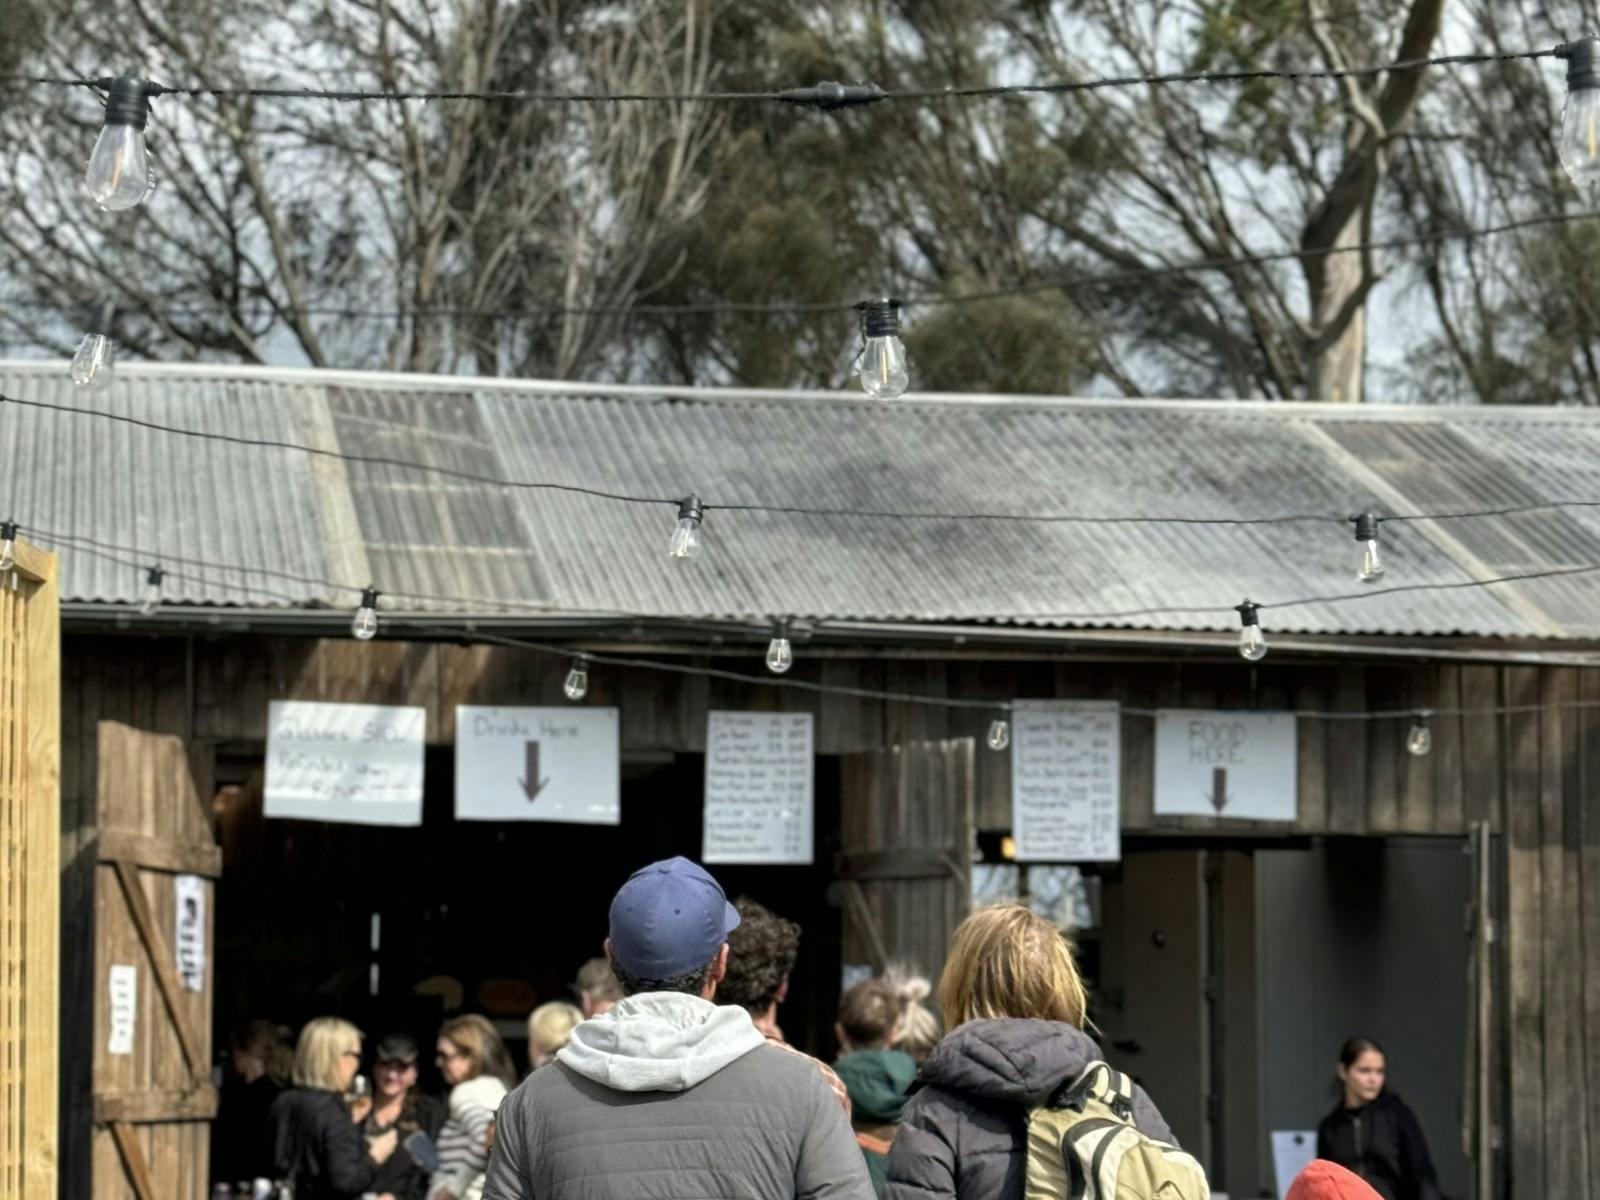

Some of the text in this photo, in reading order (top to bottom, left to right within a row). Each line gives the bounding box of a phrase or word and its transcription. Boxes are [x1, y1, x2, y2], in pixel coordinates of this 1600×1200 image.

[473, 714, 579, 738] Drinks Here
[1188, 720, 1247, 744] FOOD
